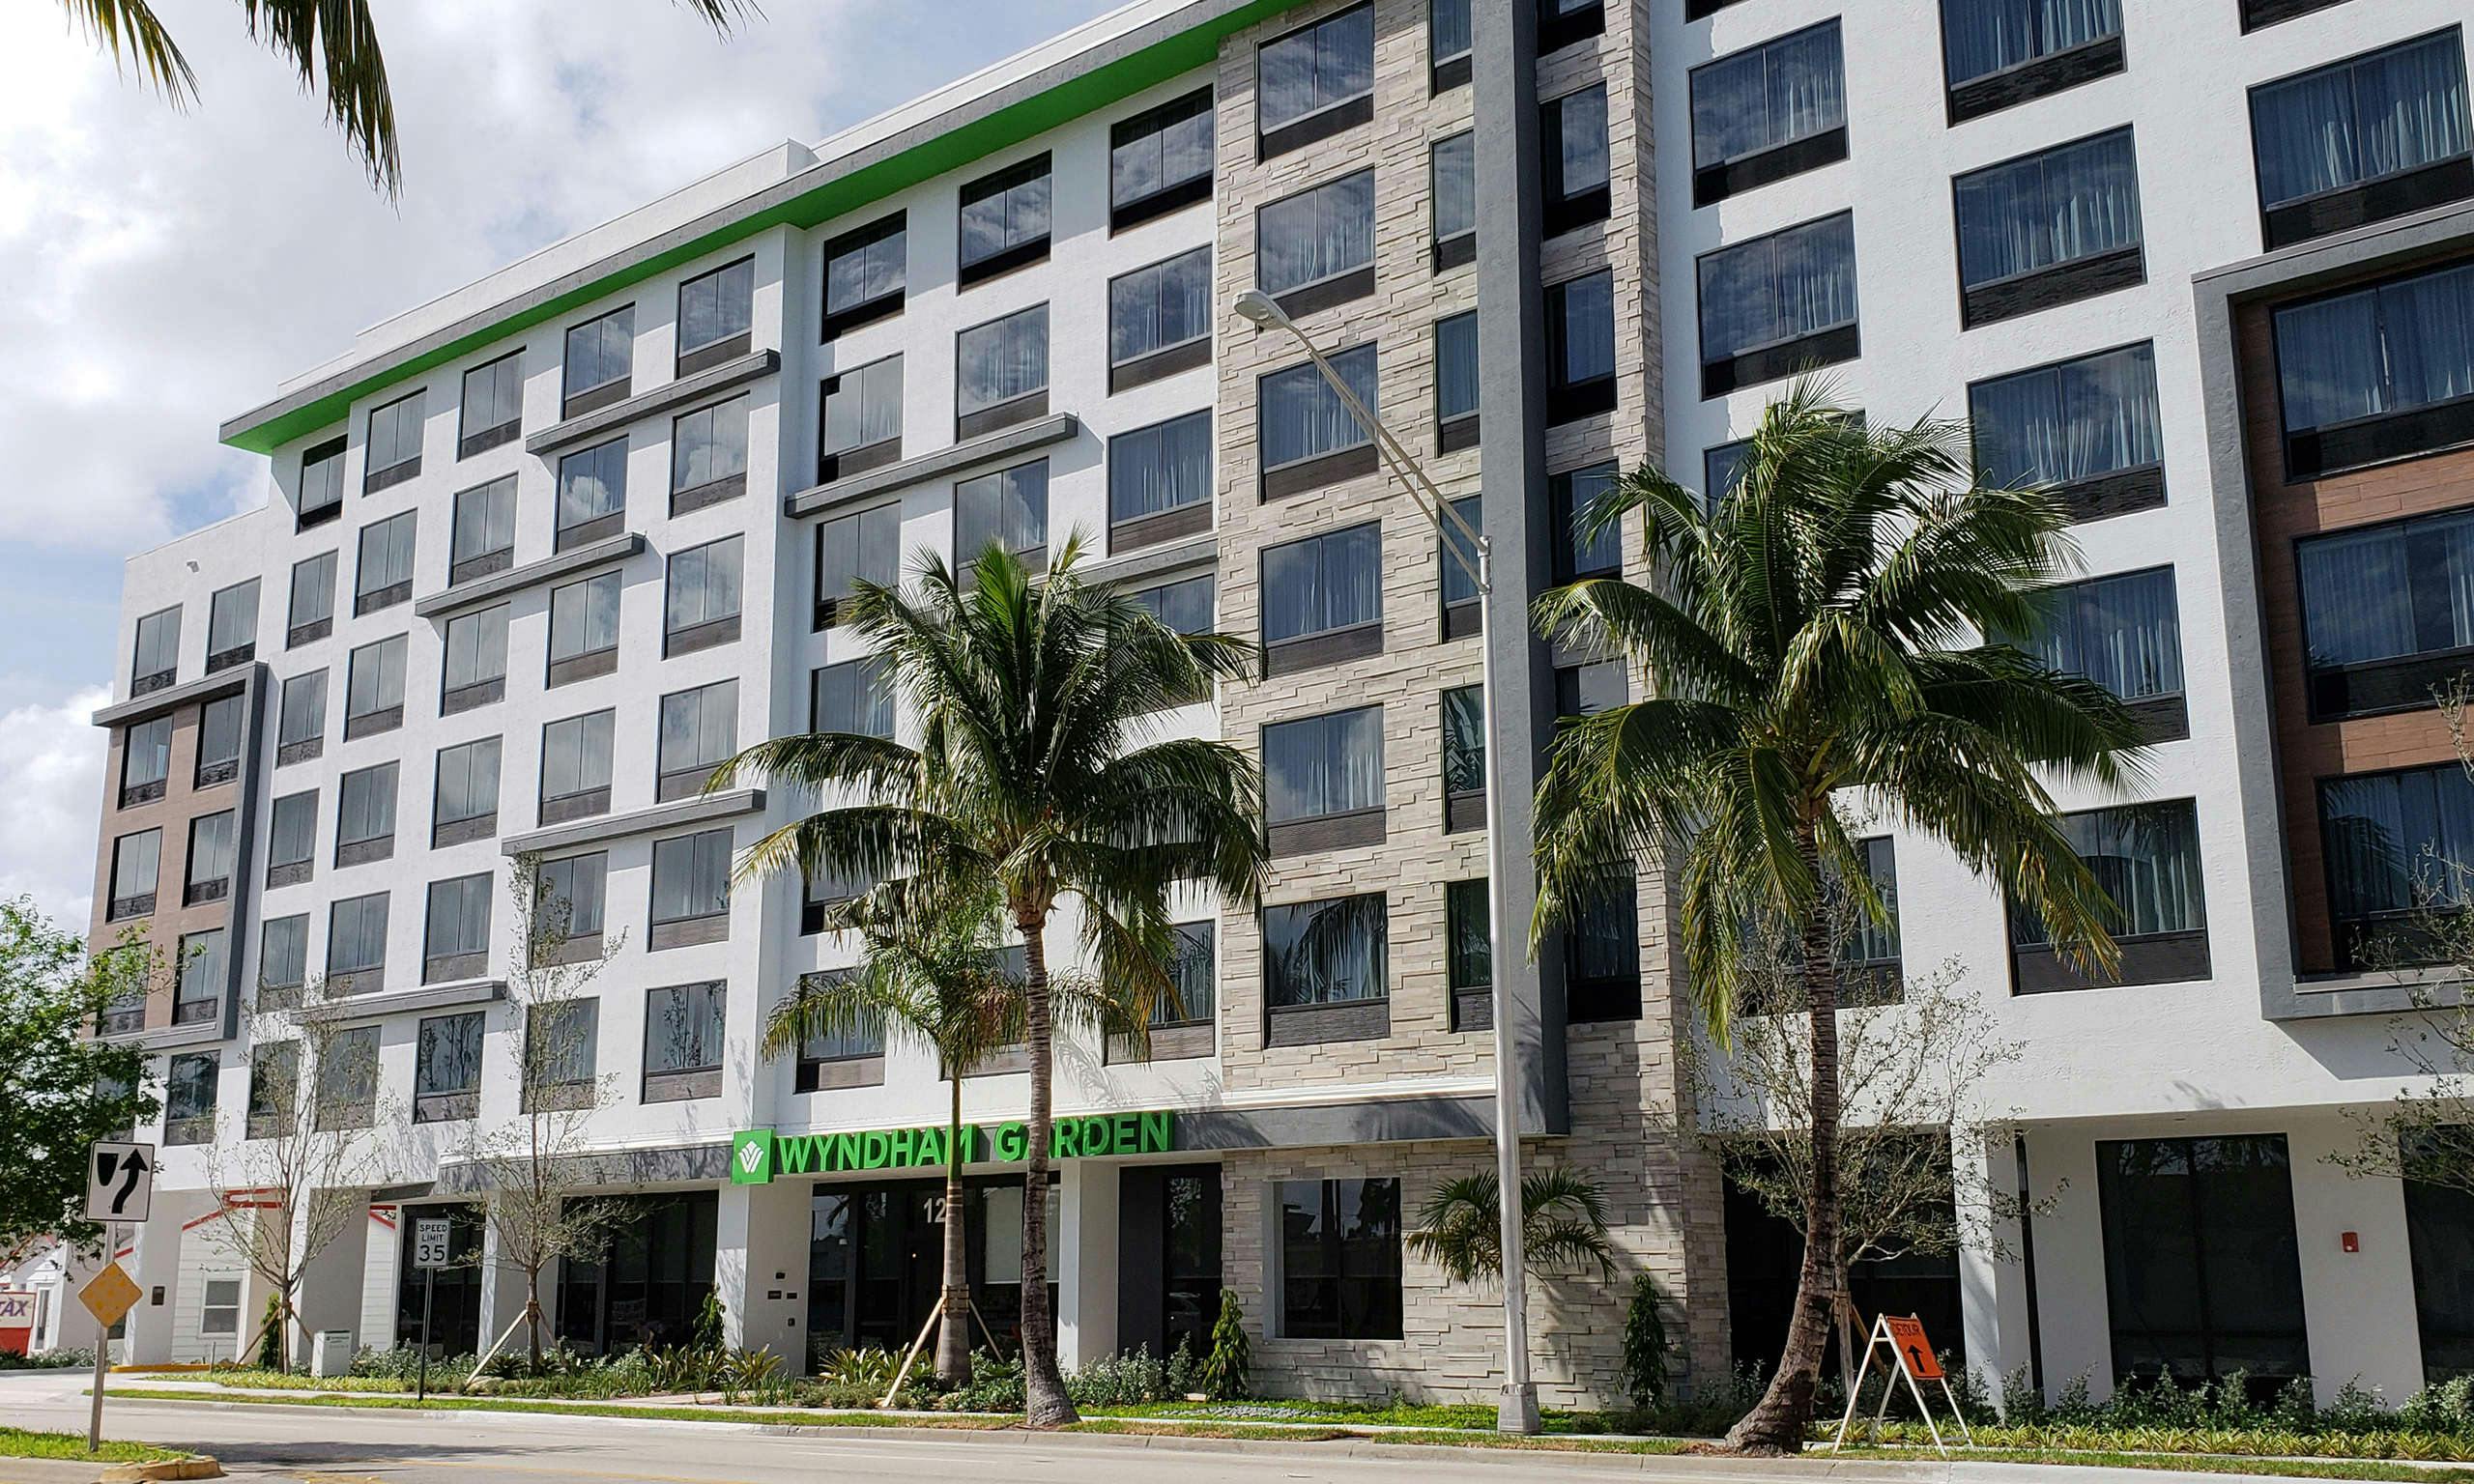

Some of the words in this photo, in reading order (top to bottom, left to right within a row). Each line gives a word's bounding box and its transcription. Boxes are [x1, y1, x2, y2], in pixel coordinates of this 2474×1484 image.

[778, 1124, 977, 1175] WYNDHAM
[993, 1110, 1173, 1162] GRDEN
[421, 1234, 443, 1242] LIMIT
[418, 1244, 445, 1262] 35
